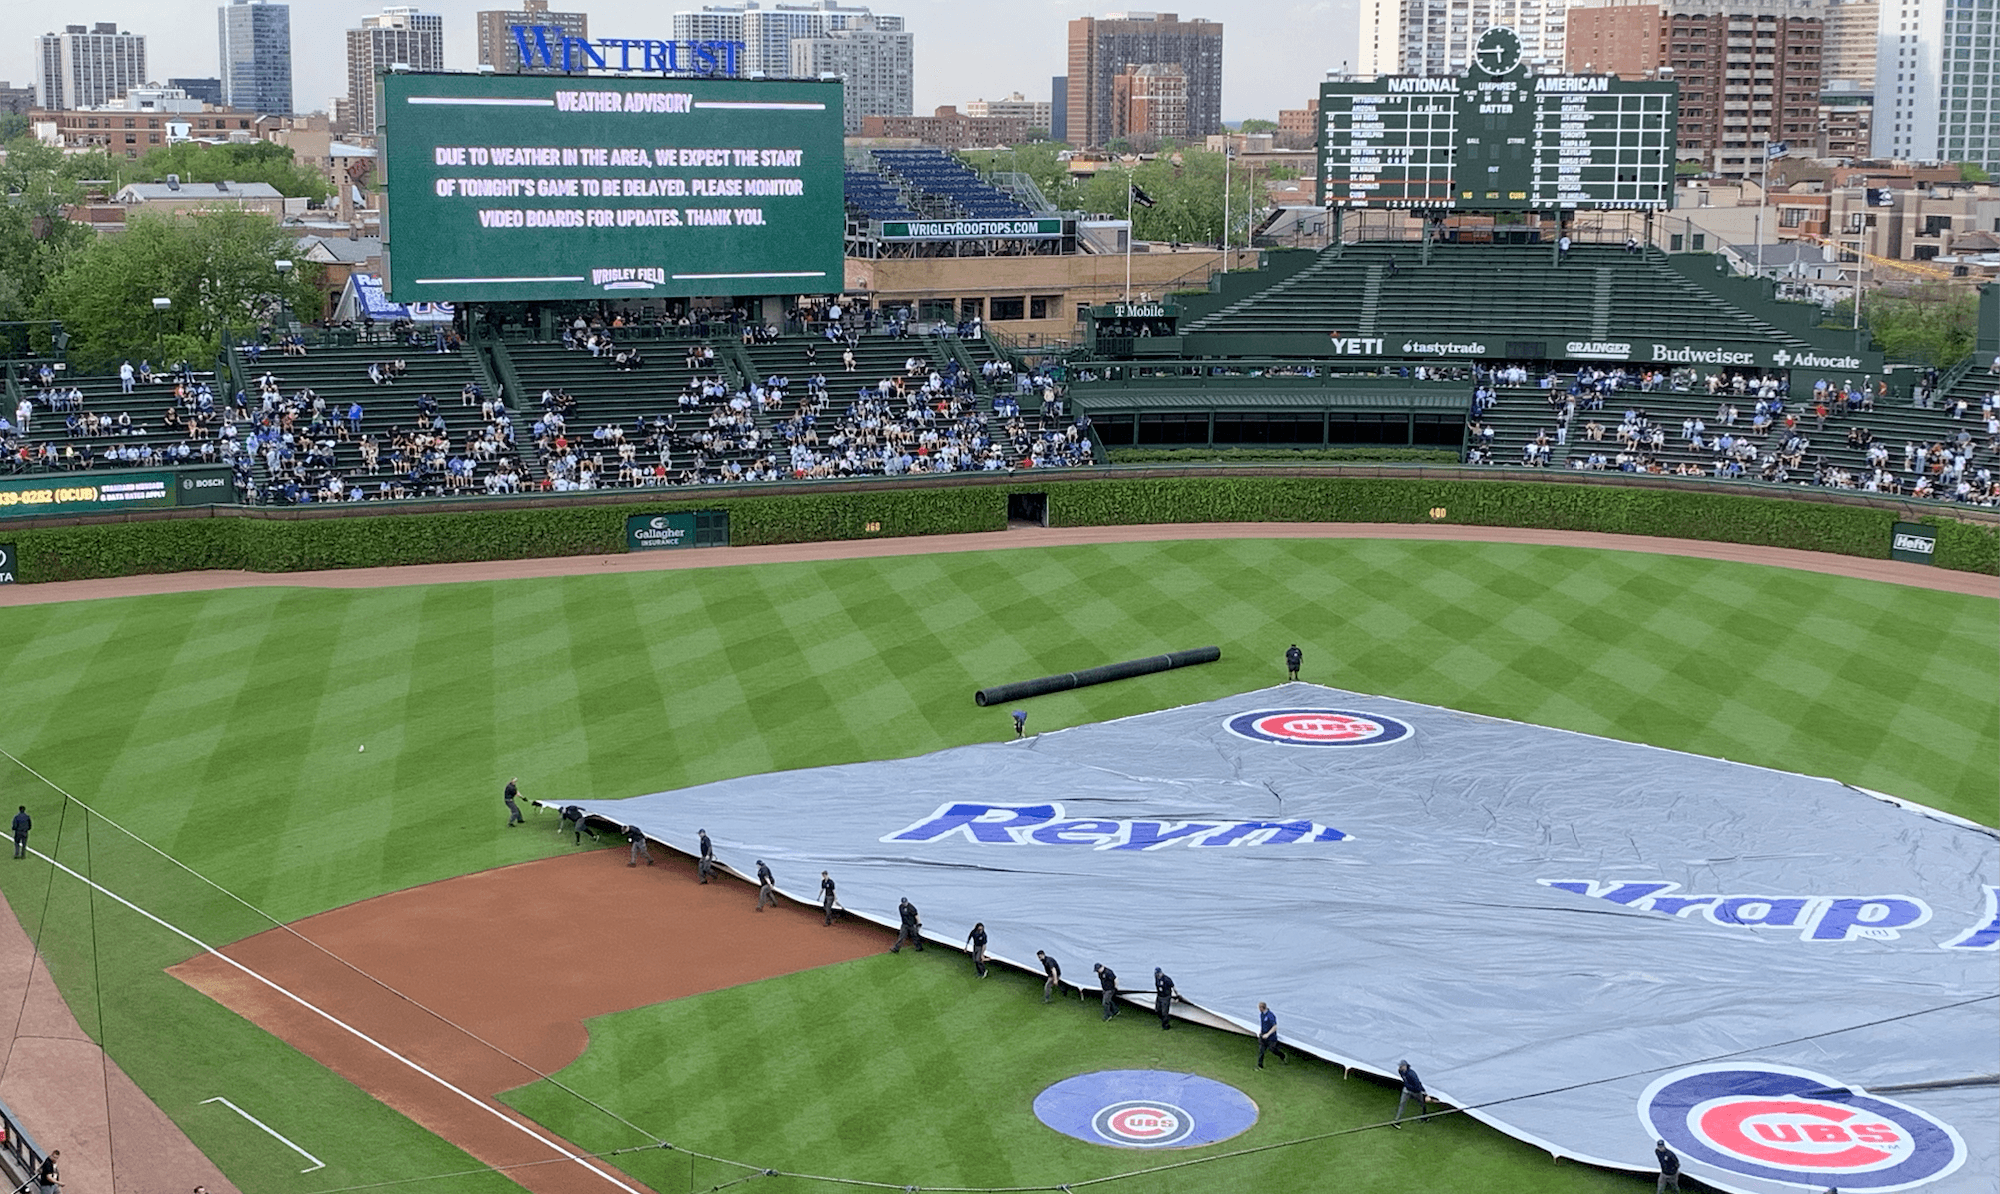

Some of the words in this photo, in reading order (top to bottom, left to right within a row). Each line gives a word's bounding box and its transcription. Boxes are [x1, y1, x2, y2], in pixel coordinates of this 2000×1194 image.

[511, 25, 746, 75] WINTRUST
[1388, 78, 1460, 92] NATIONAL
[1478, 82, 1518, 91] UMPIRES
[1535, 78, 1609, 92] AMERICAN
[556, 91, 623, 112] WEATHER
[624, 92, 693, 113] ADVISORY
[1479, 104, 1513, 114] BATTER
[435, 148, 466, 166] DUE
[468, 148, 489, 166] TO
[490, 148, 560, 166] WEATHER
[563, 149, 578, 166] IN
[580, 149, 608, 166] THE
[610, 149, 653, 169] AREA,
[655, 149, 677, 167] WE
[679, 149, 731, 167] EXPECT
[732, 149, 759, 167] THE
[761, 149, 803, 167] START
[436, 179, 456, 197] OF
[458, 179, 535, 197] TONIGHT'S
[537, 179, 579, 197] GAME
[581, 179, 600, 197] TO
[602, 179, 621, 197] BE
[623, 179, 690, 197] DELAYED.
[692, 179, 742, 196] PLEASE
[744, 179, 804, 196] MONITOR
[1392, 200, 1398, 208] 2
[1400, 200, 1406, 208] 3
[1406, 200, 1412, 208] 4
[1413, 200, 1419, 208] 5
[1420, 200, 1426, 208] 6
[1428, 200, 1433, 208] 7
[1435, 200, 1440, 208] 8
[1441, 200, 1447, 208] 9
[1447, 200, 1456, 208] 10
[479, 209, 524, 227] VIDEO
[525, 209, 584, 227] BOARDS
[586, 209, 614, 227] FOR
[616, 209, 684, 226] UPDATES.
[685, 209, 732, 226] THANK
[734, 208, 767, 226] YOU.
[908, 222, 1039, 236] WRIGLEYROOFTOPS.COM
[592, 268, 636, 285] WRIGLEY
[637, 267, 665, 284] FIELD
[1127, 305, 1165, 317] Mobile
[1331, 338, 1383, 354] YETI
[1413, 340, 1486, 356] tastytrade
[1566, 342, 1632, 354] GRAINGER
[1793, 353, 1861, 369] Advocate
[101, 483, 135, 493] STANDARD
[136, 481, 165, 491] MESSAGE
[196, 478, 225, 488] BOSCH
[0, 489, 53, 505] 39-0282
[107, 492, 124, 501] DATA
[125, 491, 145, 500] RATES
[145, 490, 166, 499] APPLY
[1429, 507, 1447, 518] 400
[635, 528, 685, 540] Gallagher
[641, 538, 679, 546] INSURANCE
[1896, 536, 1932, 552] Hefty
